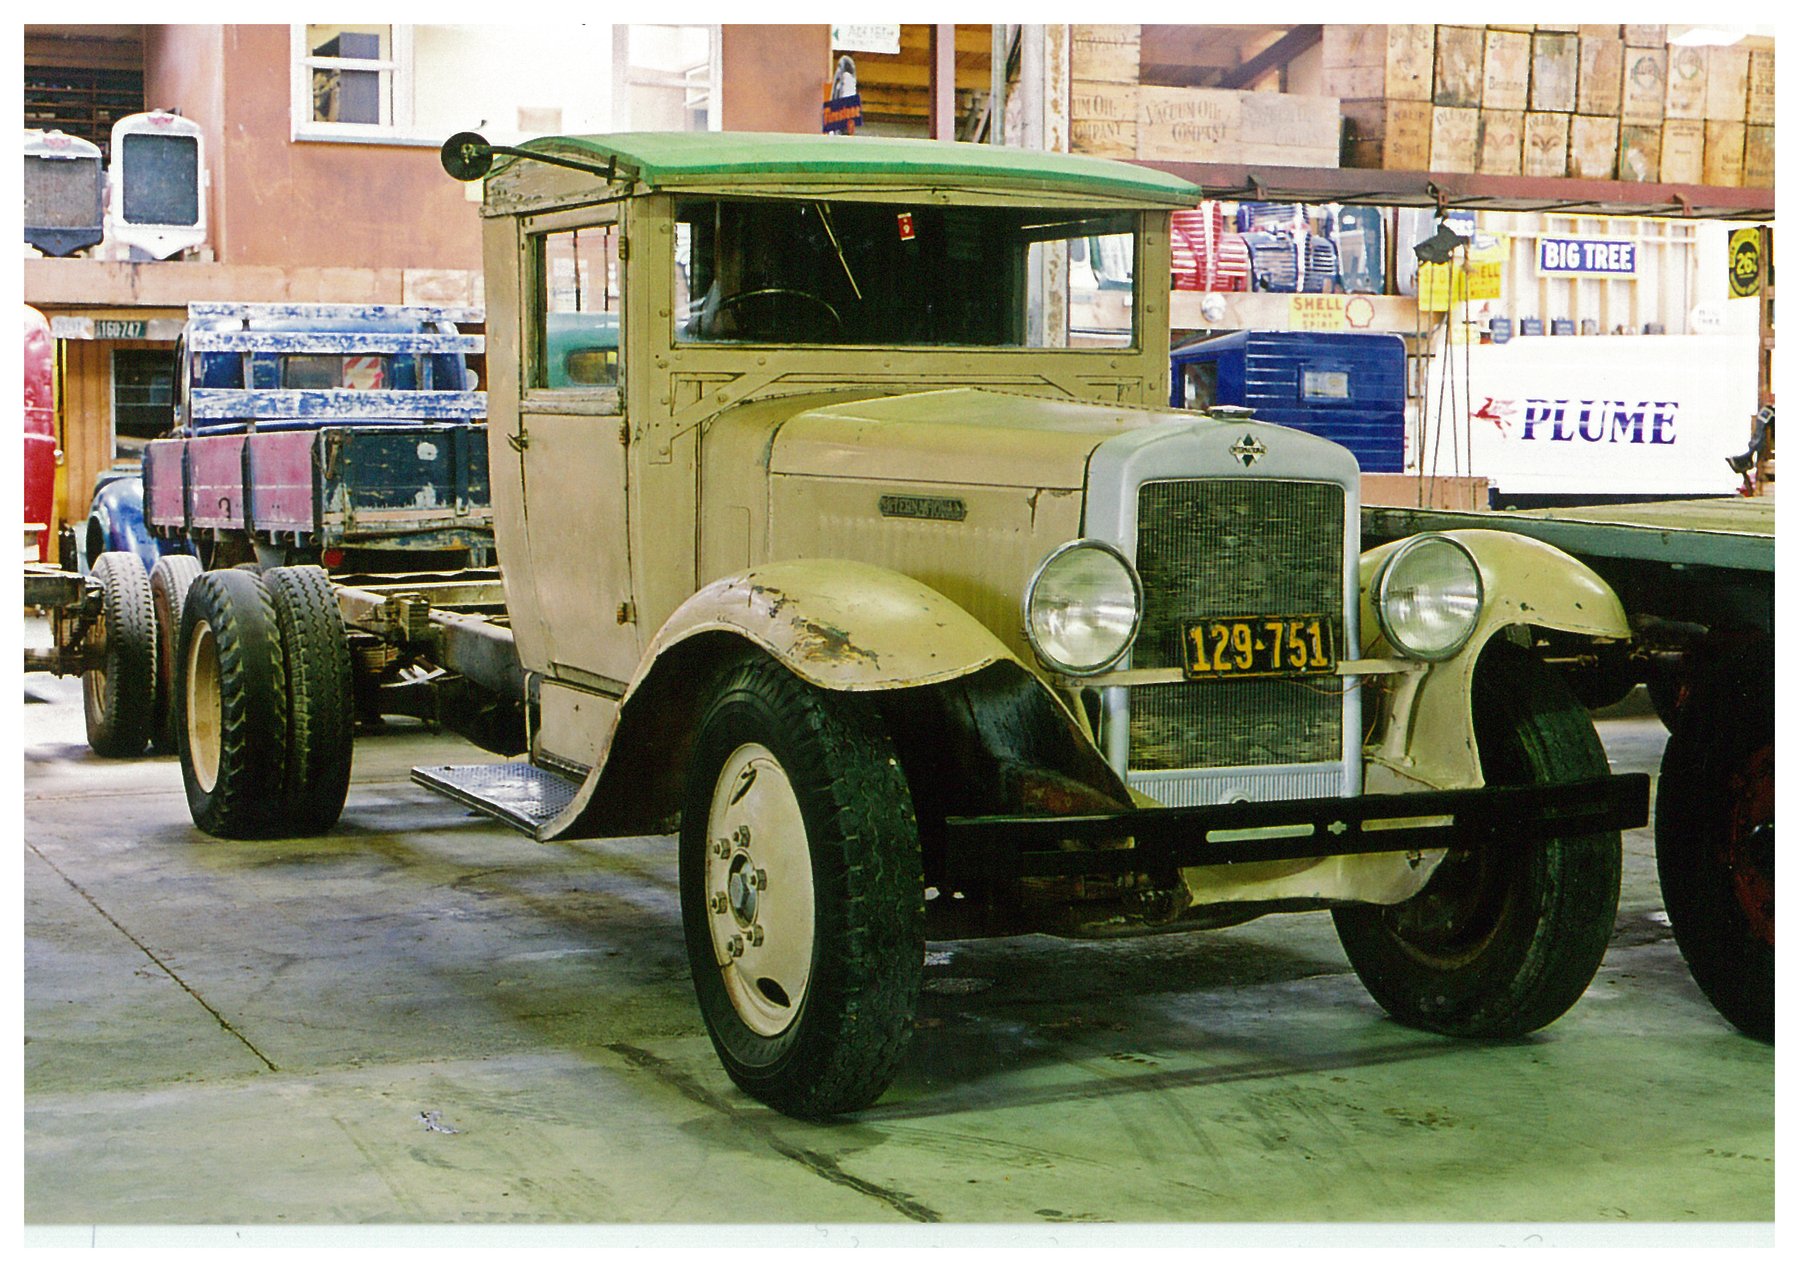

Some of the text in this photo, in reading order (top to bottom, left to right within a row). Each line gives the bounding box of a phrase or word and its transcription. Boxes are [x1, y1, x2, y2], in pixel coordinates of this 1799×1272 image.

[1544, 240, 1632, 270] BIG TREE
[1293, 296, 1343, 311] SHELL
[1521, 398, 1679, 445] PLUME
